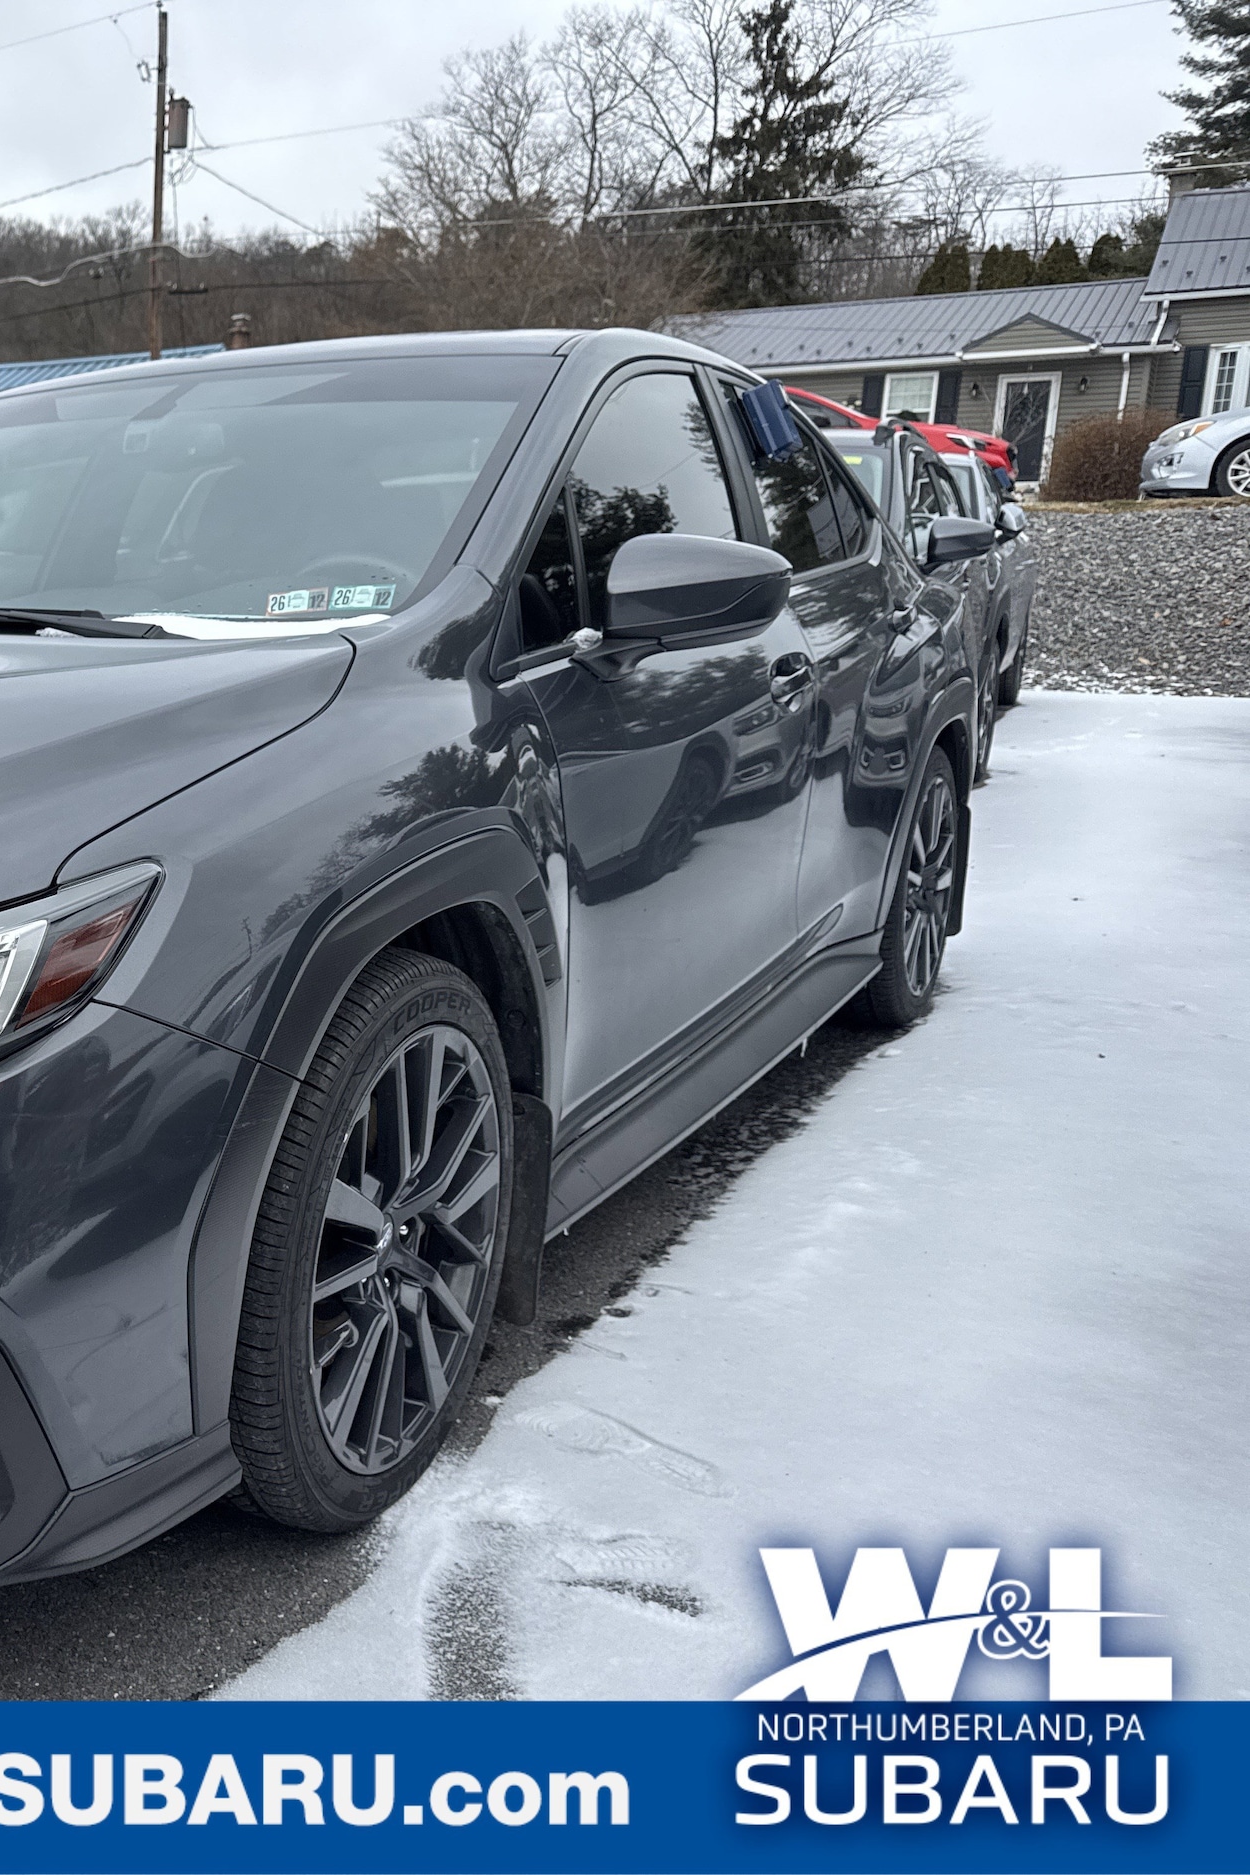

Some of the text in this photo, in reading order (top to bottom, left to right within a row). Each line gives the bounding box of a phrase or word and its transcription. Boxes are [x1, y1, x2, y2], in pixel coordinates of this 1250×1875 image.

[271, 594, 324, 611] 26 12
[334, 590, 391, 605] 26 12
[394, 990, 471, 1035] COOPER
